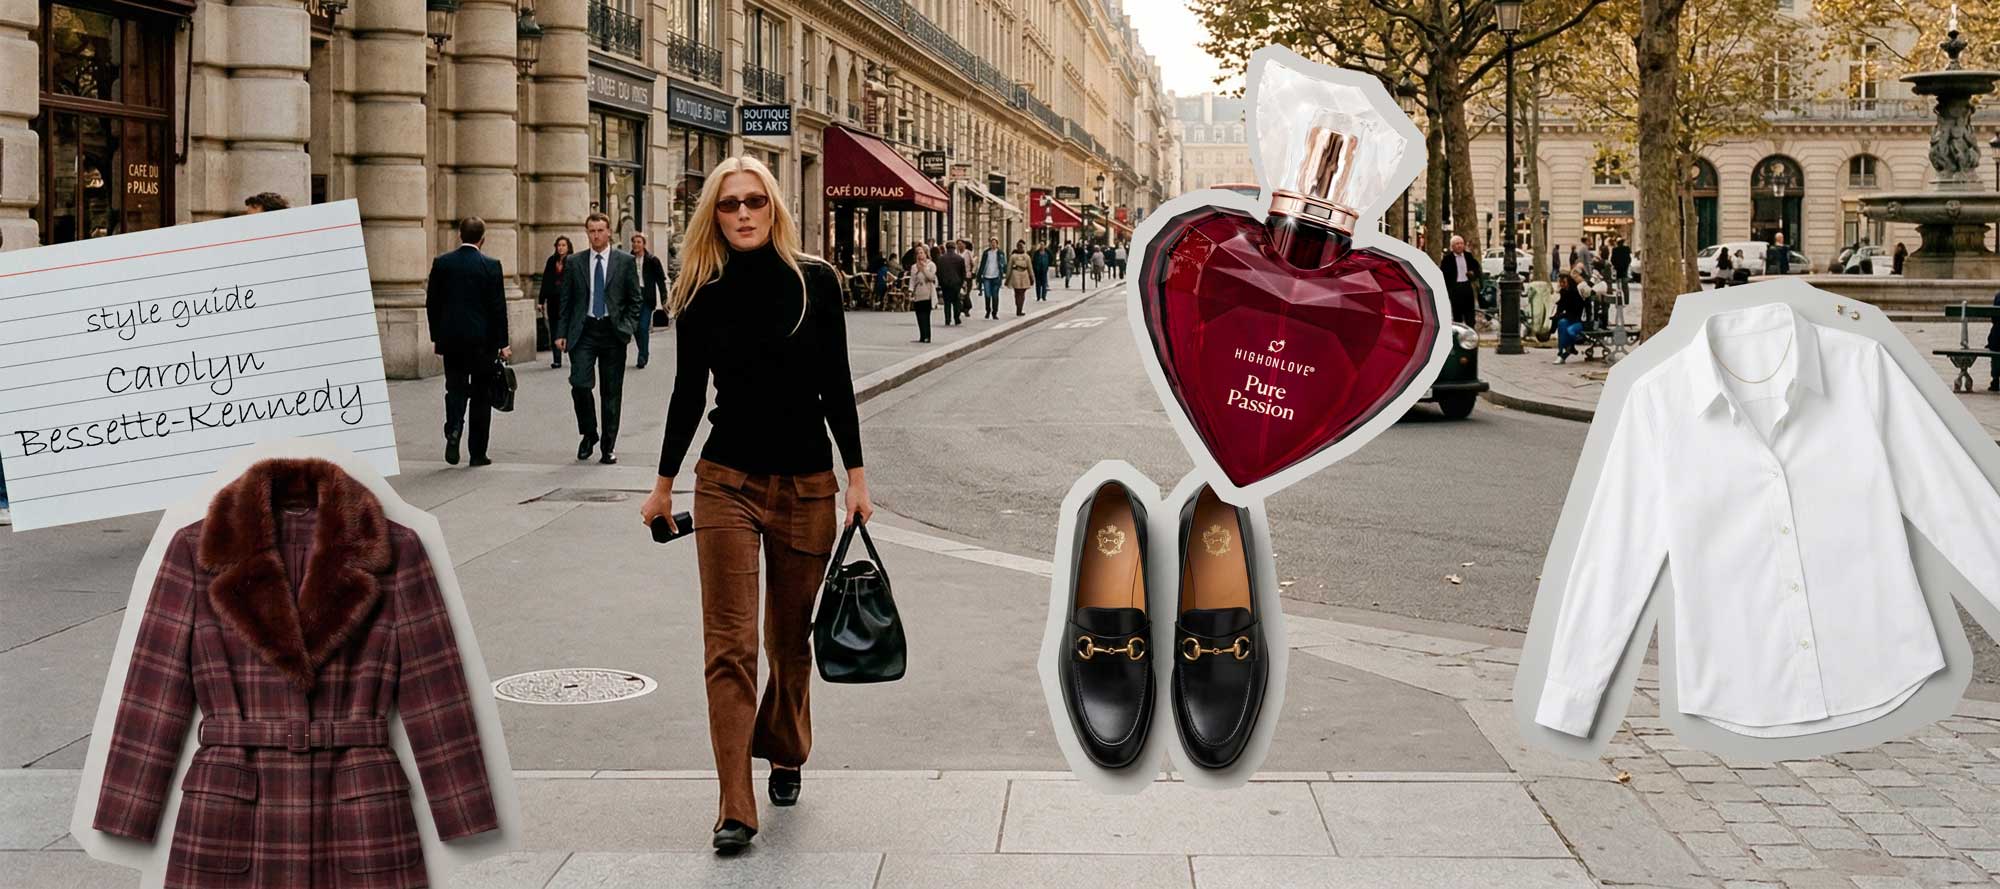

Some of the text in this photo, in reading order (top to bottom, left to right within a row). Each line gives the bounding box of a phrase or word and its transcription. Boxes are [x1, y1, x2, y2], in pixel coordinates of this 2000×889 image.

[743, 108, 790, 121] BOUTIQUE
[745, 121, 788, 131] DES ARTS
[149, 165, 159, 178] DU
[133, 180, 159, 195] PALAIS
[825, 184, 904, 197] CAFÉ DU PALAIS
[87, 285, 257, 341] style guide
[1244, 374, 1287, 400] Pure
[1226, 388, 1295, 421] Passion
[15, 378, 364, 457] Bessette-Kennedy
